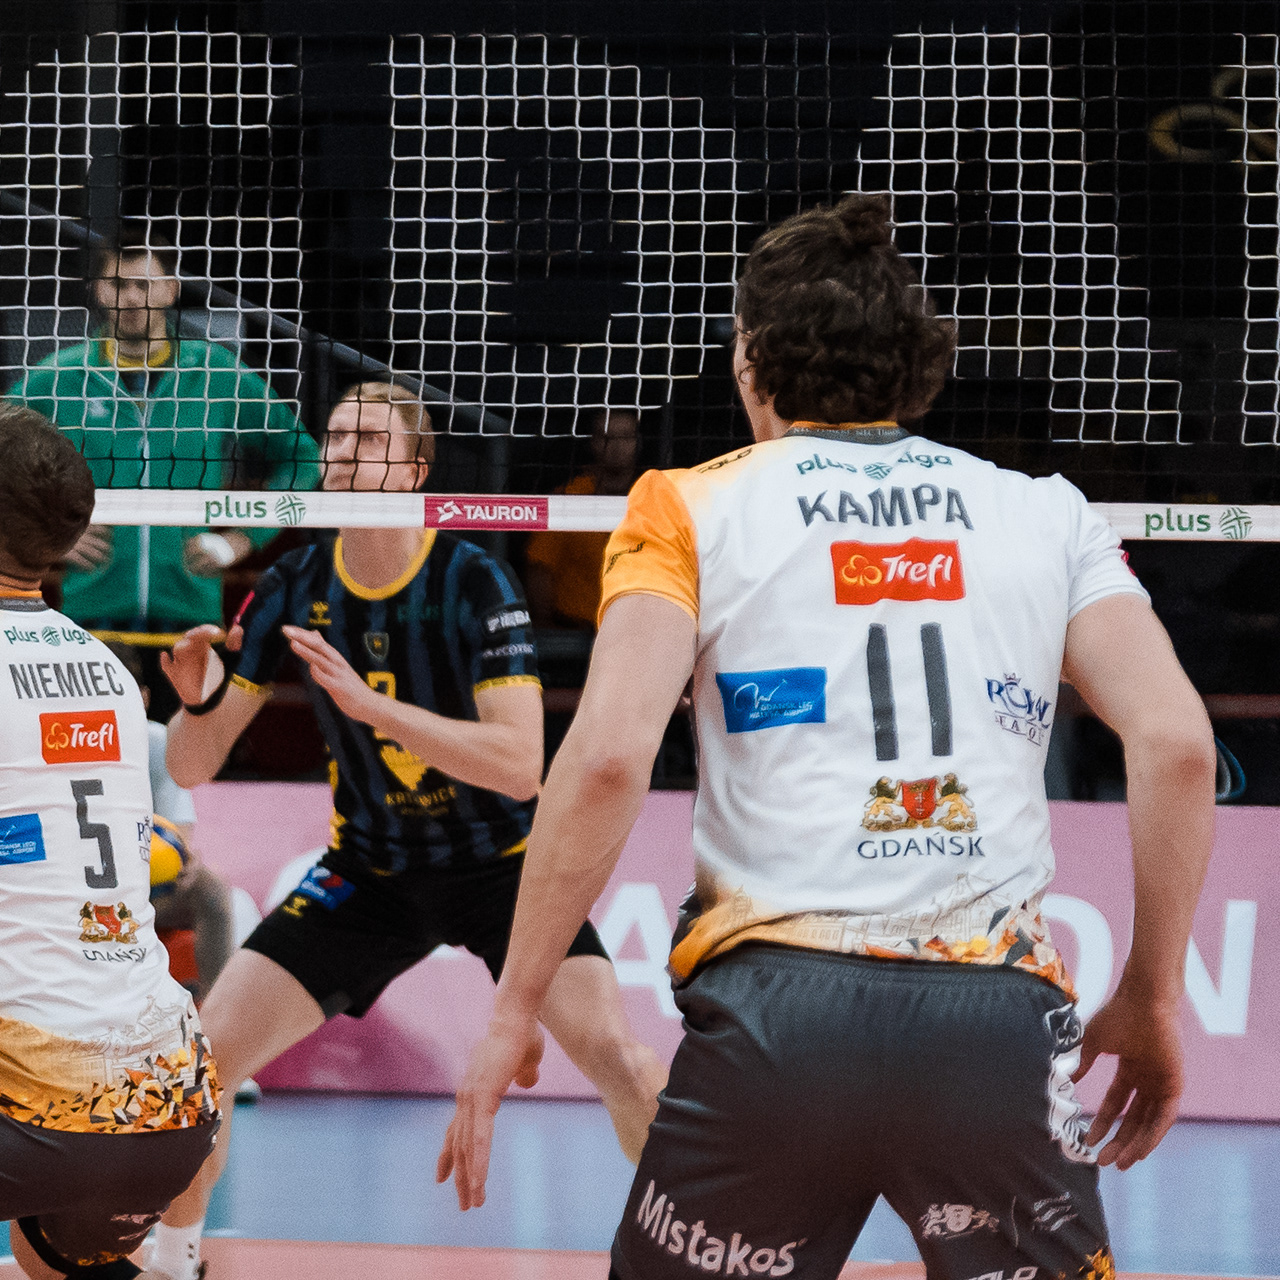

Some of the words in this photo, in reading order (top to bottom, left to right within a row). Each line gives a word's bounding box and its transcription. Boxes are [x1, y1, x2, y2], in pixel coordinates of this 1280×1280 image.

[205, 495, 268, 524] plus
[463, 504, 538, 522] TAURON
[797, 483, 974, 531] KAMPA
[1144, 507, 1212, 538] plus
[881, 553, 953, 588] Trefl
[4, 626, 40, 645] plus
[9, 661, 125, 700] NIEMIEC
[866, 622, 954, 762] 11
[70, 722, 115, 752] Trefl
[69, 778, 120, 889] 5
[857, 832, 986, 860] GDAŃSK
[638, 1180, 797, 1278] Mistakos
